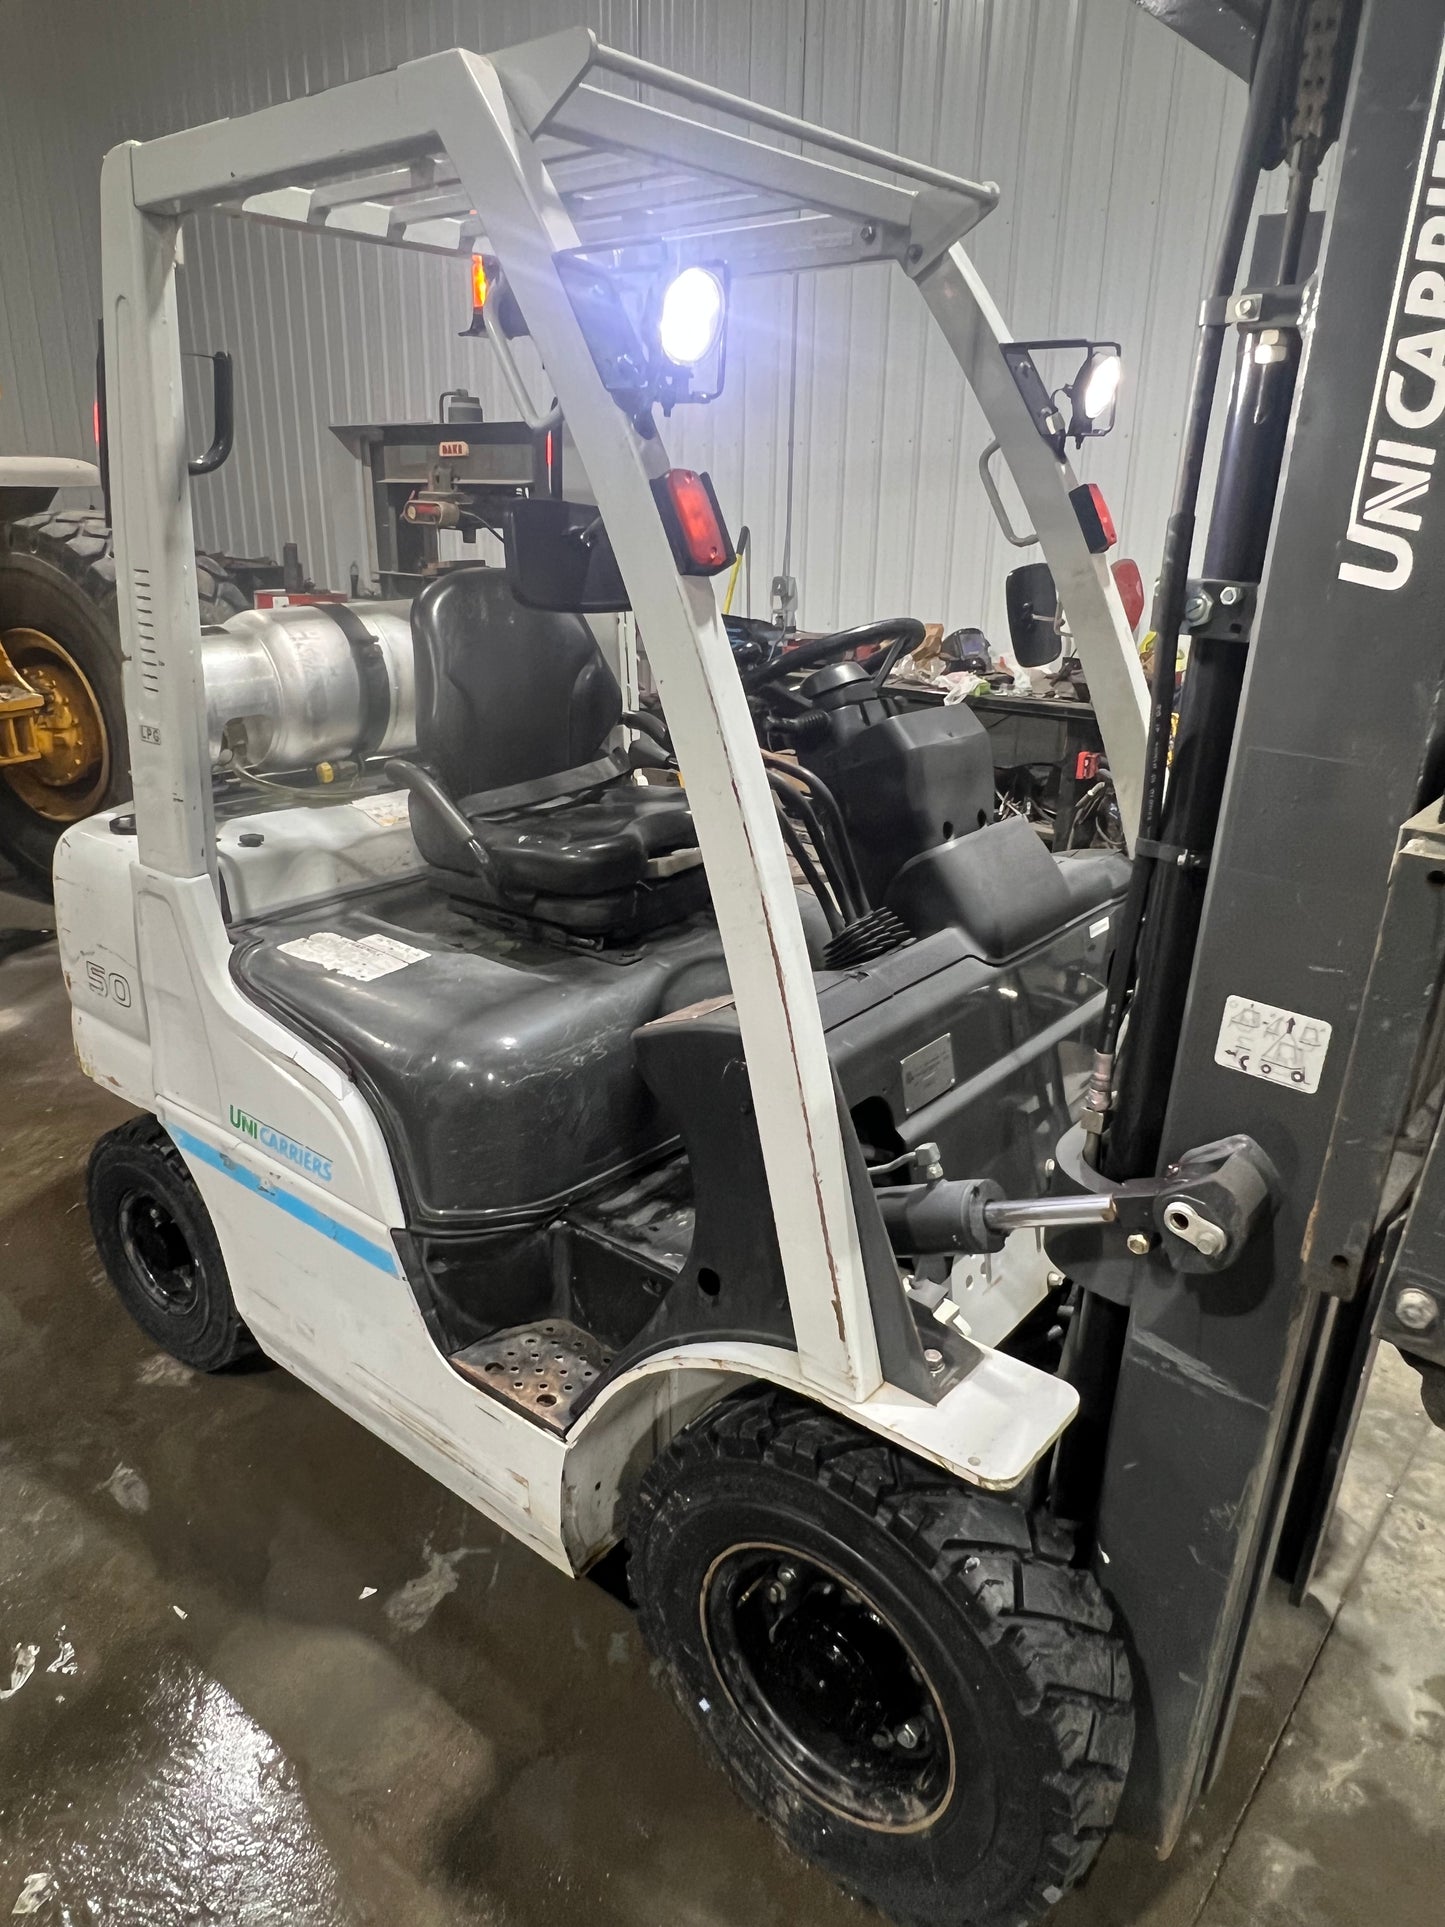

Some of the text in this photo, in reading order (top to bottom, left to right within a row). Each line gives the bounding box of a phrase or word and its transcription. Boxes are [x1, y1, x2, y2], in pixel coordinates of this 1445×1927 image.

[1338, 110, 1445, 591] UNICARR
[140, 725, 160, 743] LPG
[86, 960, 131, 1008] 50
